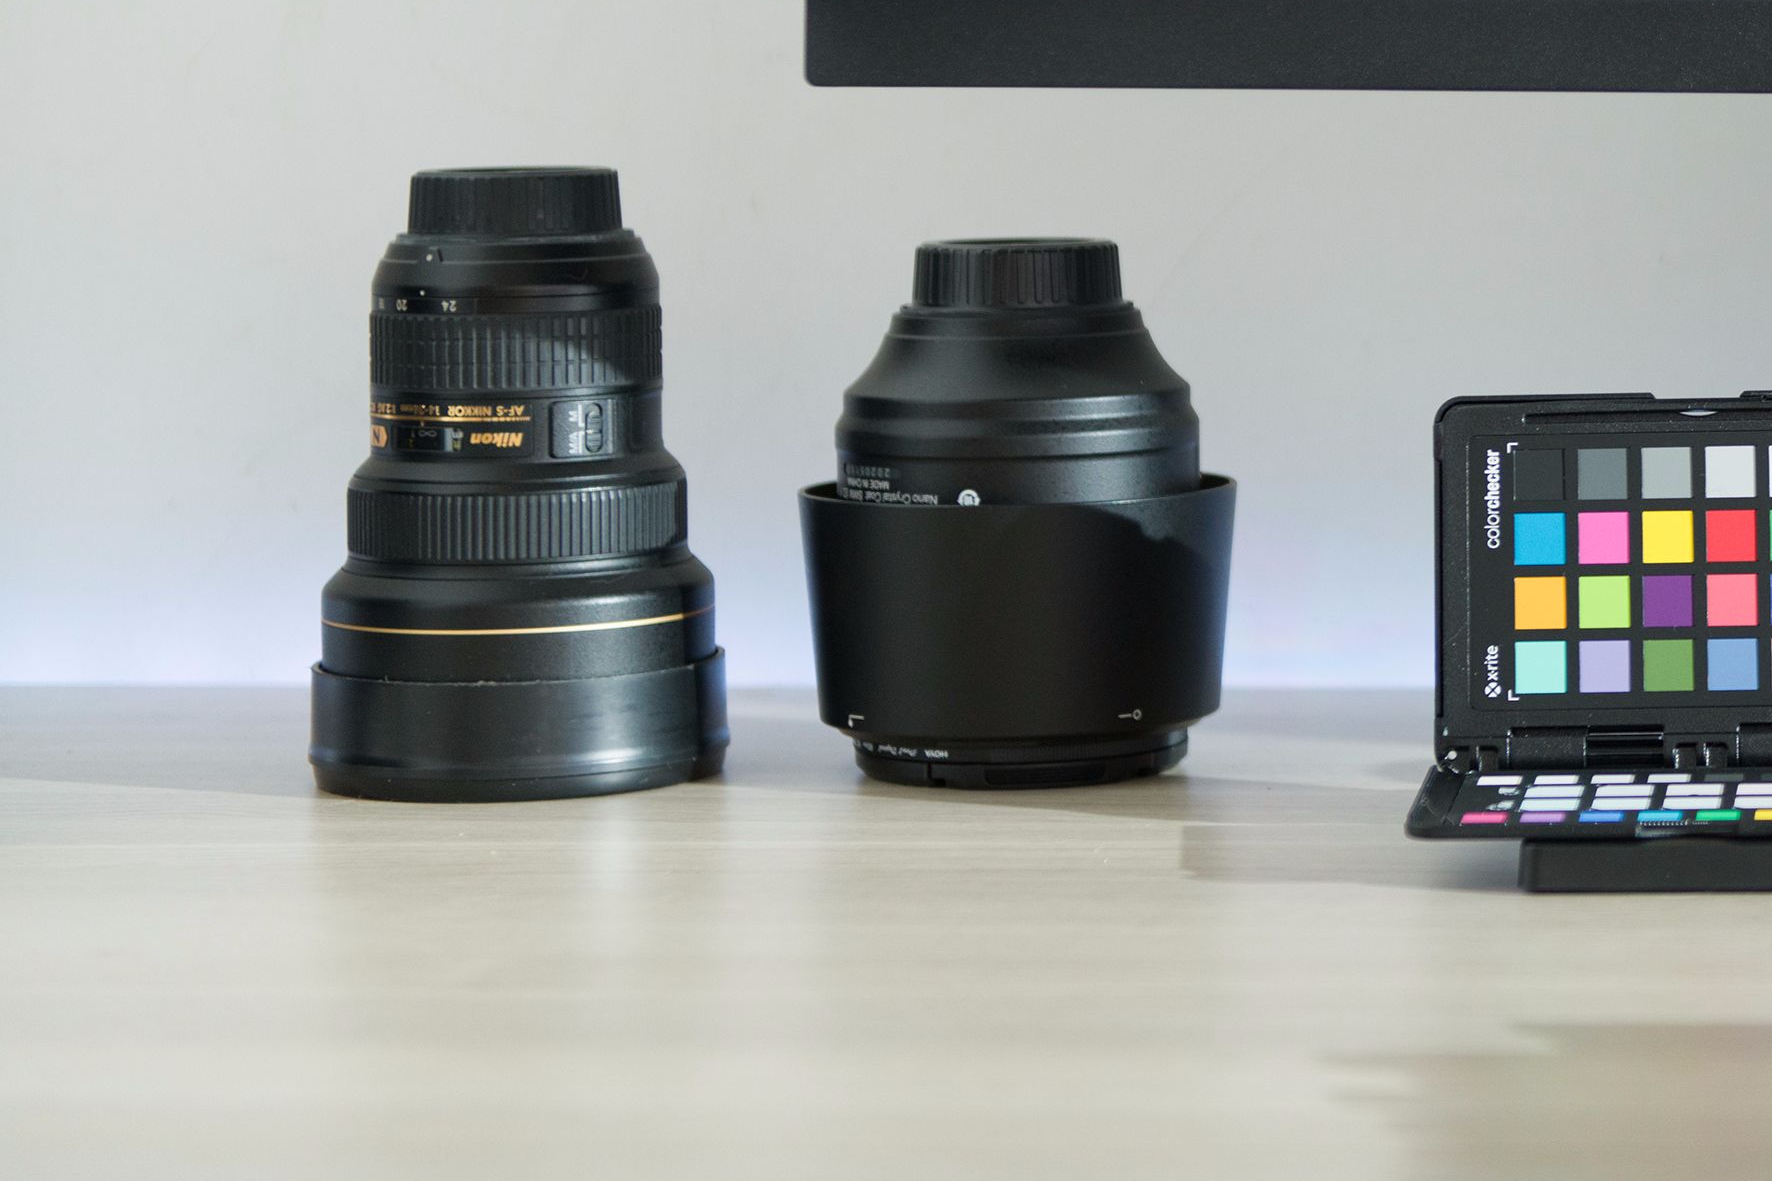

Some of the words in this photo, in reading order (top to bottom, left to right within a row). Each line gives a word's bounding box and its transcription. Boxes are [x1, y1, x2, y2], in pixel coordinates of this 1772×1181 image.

[441, 299, 458, 313] 24
[447, 404, 493, 417] NIKKOR
[495, 405, 525, 416] AF-S
[470, 431, 524, 449] Nikon
[912, 494, 938, 506] Nano
[1483, 449, 1501, 549] colorchecker
